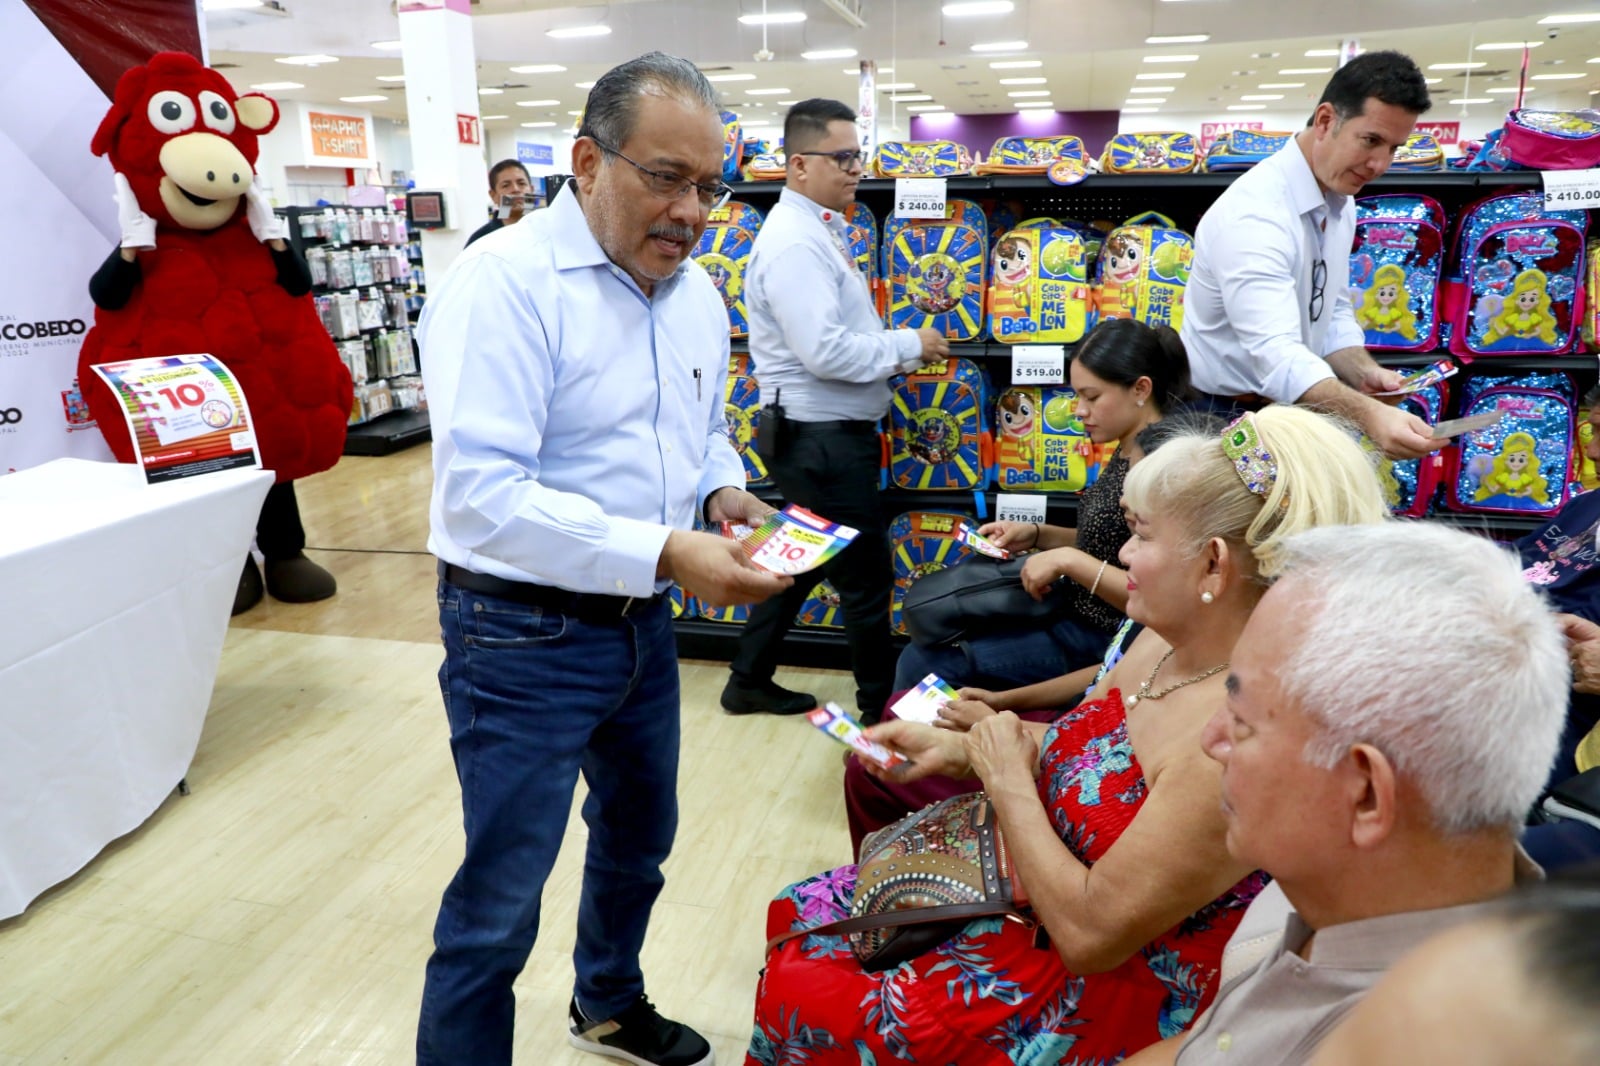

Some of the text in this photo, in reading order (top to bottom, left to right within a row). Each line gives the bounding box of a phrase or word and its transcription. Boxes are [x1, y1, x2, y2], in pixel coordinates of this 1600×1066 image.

[311, 117, 365, 137] GRAPHIC
[319, 136, 363, 155] T-SHIRT
[1545, 190, 1600, 202] $ 410.00
[898, 201, 944, 211] $ 240.00
[1041, 301, 1065, 314] ME
[1147, 304, 1171, 318] ME
[0, 319, 86, 341] COBEDO
[1015, 368, 1062, 377] $ 519.00
[157, 383, 206, 411] 10
[1044, 455, 1068, 467] ME
[999, 513, 1044, 523] $ 519.00
[778, 542, 806, 561] 10
